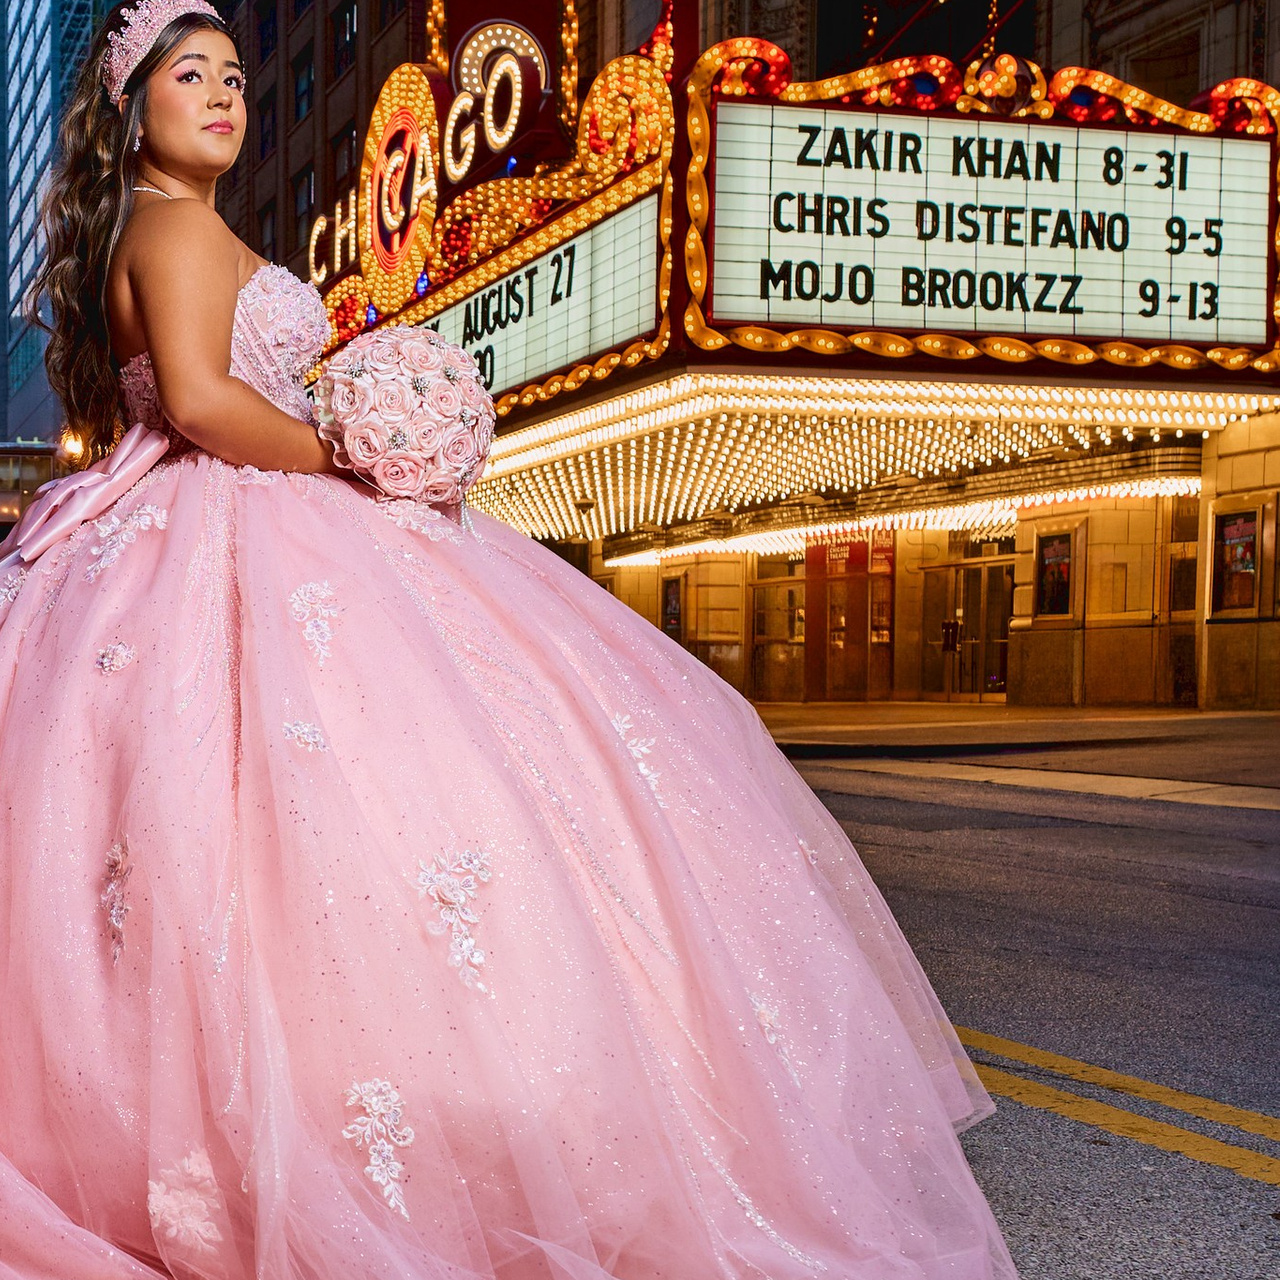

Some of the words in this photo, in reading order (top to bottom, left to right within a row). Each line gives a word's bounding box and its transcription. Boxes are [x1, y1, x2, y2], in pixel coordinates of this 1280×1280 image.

[309, 52, 523, 287] CHICAGO
[796, 123, 923, 174] ZAKIR
[951, 135, 1062, 183] KHAN
[1102, 145, 1189, 191] 8-31
[772, 191, 891, 239] CHRIS
[915, 199, 1130, 253] DISTEFANO
[1165, 216, 1224, 258] 9-5
[462, 264, 539, 350] AUGUST
[549, 243, 577, 307] 27
[759, 258, 875, 306] MOJO
[901, 265, 1085, 316] BROOKZZ
[1138, 278, 1219, 321] 9-13
